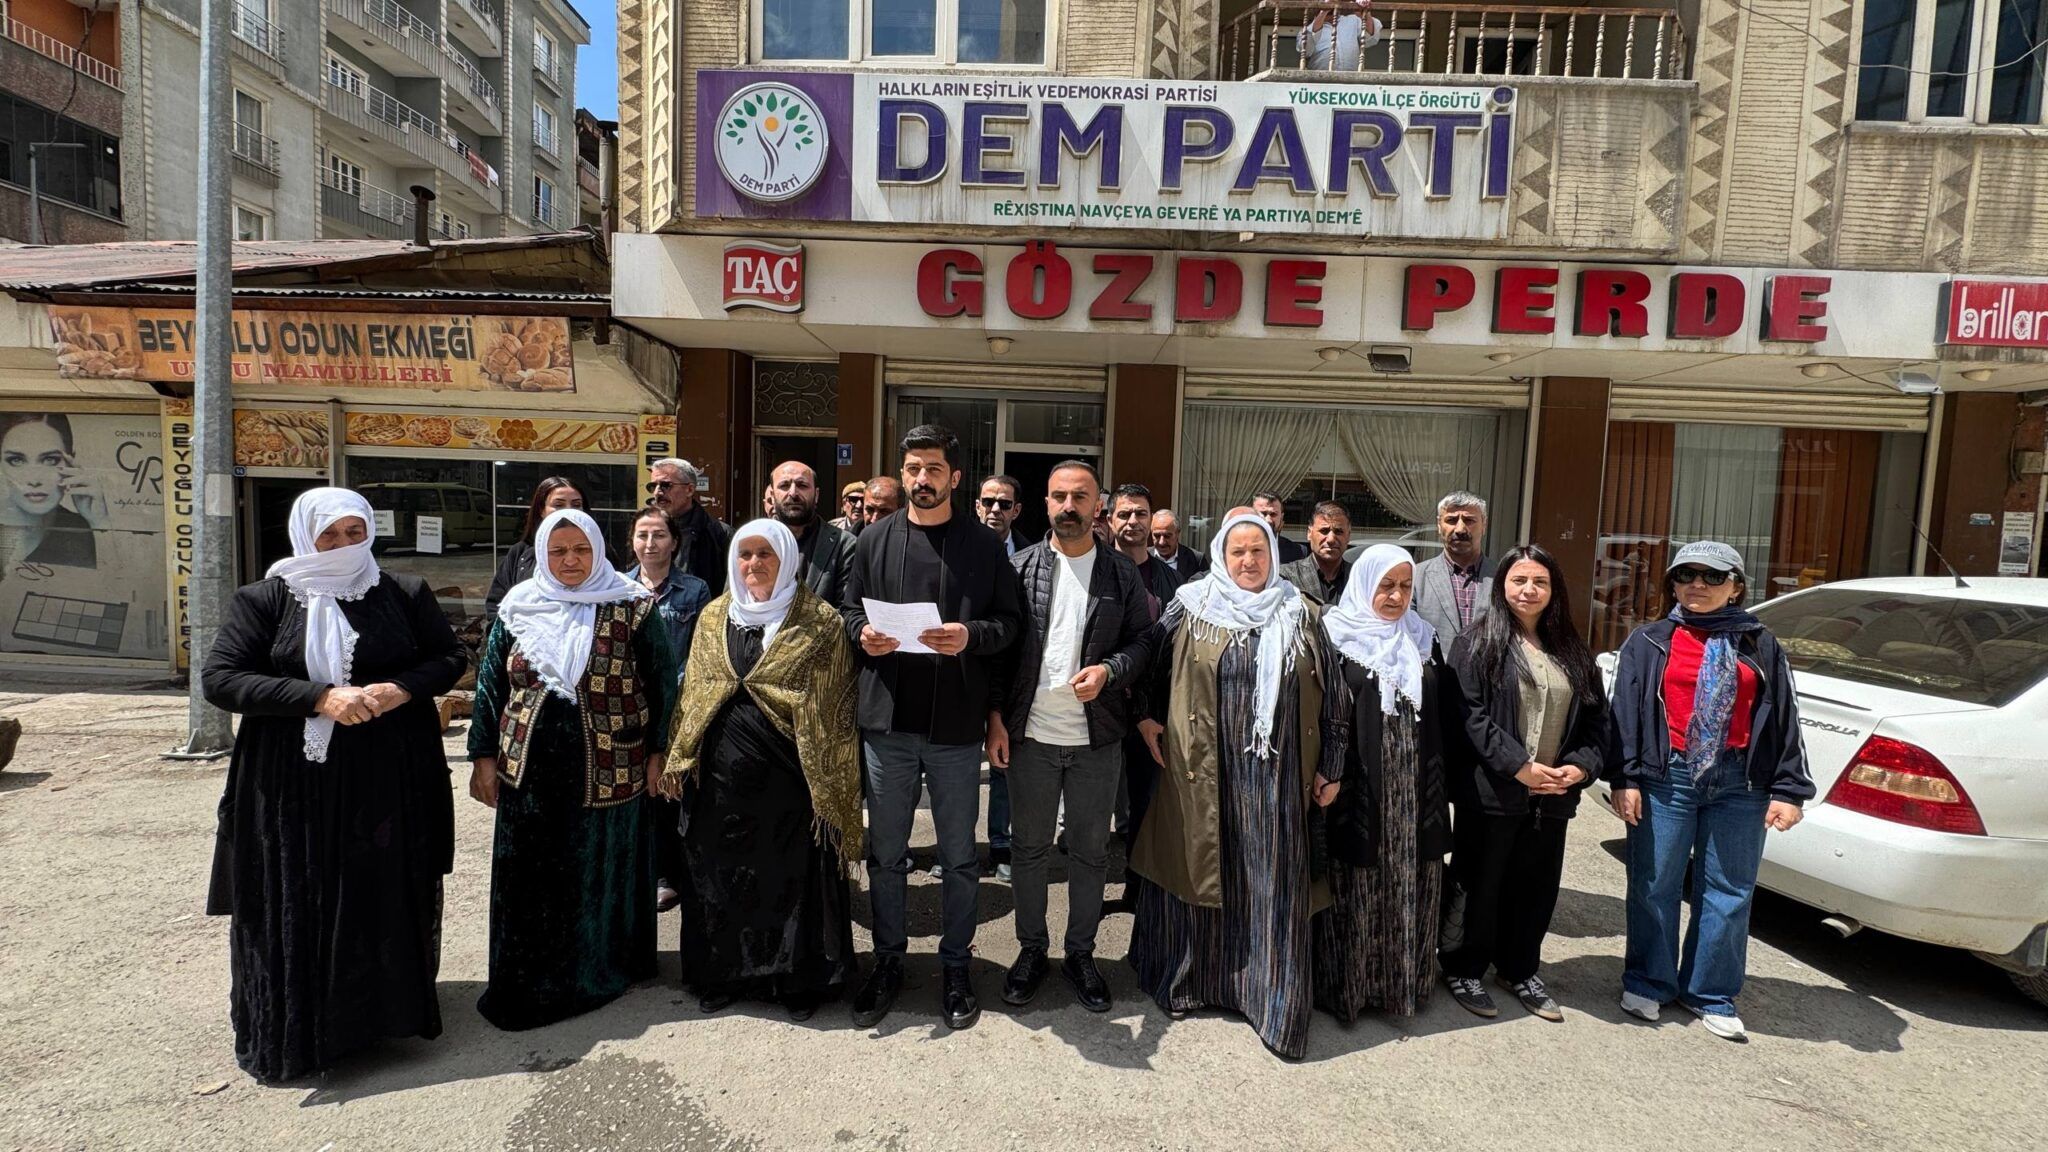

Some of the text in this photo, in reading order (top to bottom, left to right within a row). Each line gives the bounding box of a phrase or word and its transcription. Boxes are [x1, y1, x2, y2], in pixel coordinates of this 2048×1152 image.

[879, 80, 1218, 102] HALKLARIN EŞİTLİK VEDEMOKRASİ PARTİSİ
[1289, 88, 1481, 110] YÜKSEKOVA İLÇE ÖRGÜTÜ
[876, 86, 1515, 200] DEM PARTİ
[739, 173, 800, 194] DEM PARTİ
[994, 200, 1076, 217] RÊXISTINA
[1080, 204, 1153, 221] NAVÇEYA
[1157, 205, 1219, 220] GEVERÊ
[1222, 207, 1242, 221] YA
[1246, 209, 1312, 224] PARTIYA
[916, 240, 1832, 343] GÖZDE PERDE
[138, 317, 476, 361] BEYLU ODUN EKMEĞİ
[263, 361, 454, 383] MAMÜLLERİ
[842, 449, 848, 458] 8
